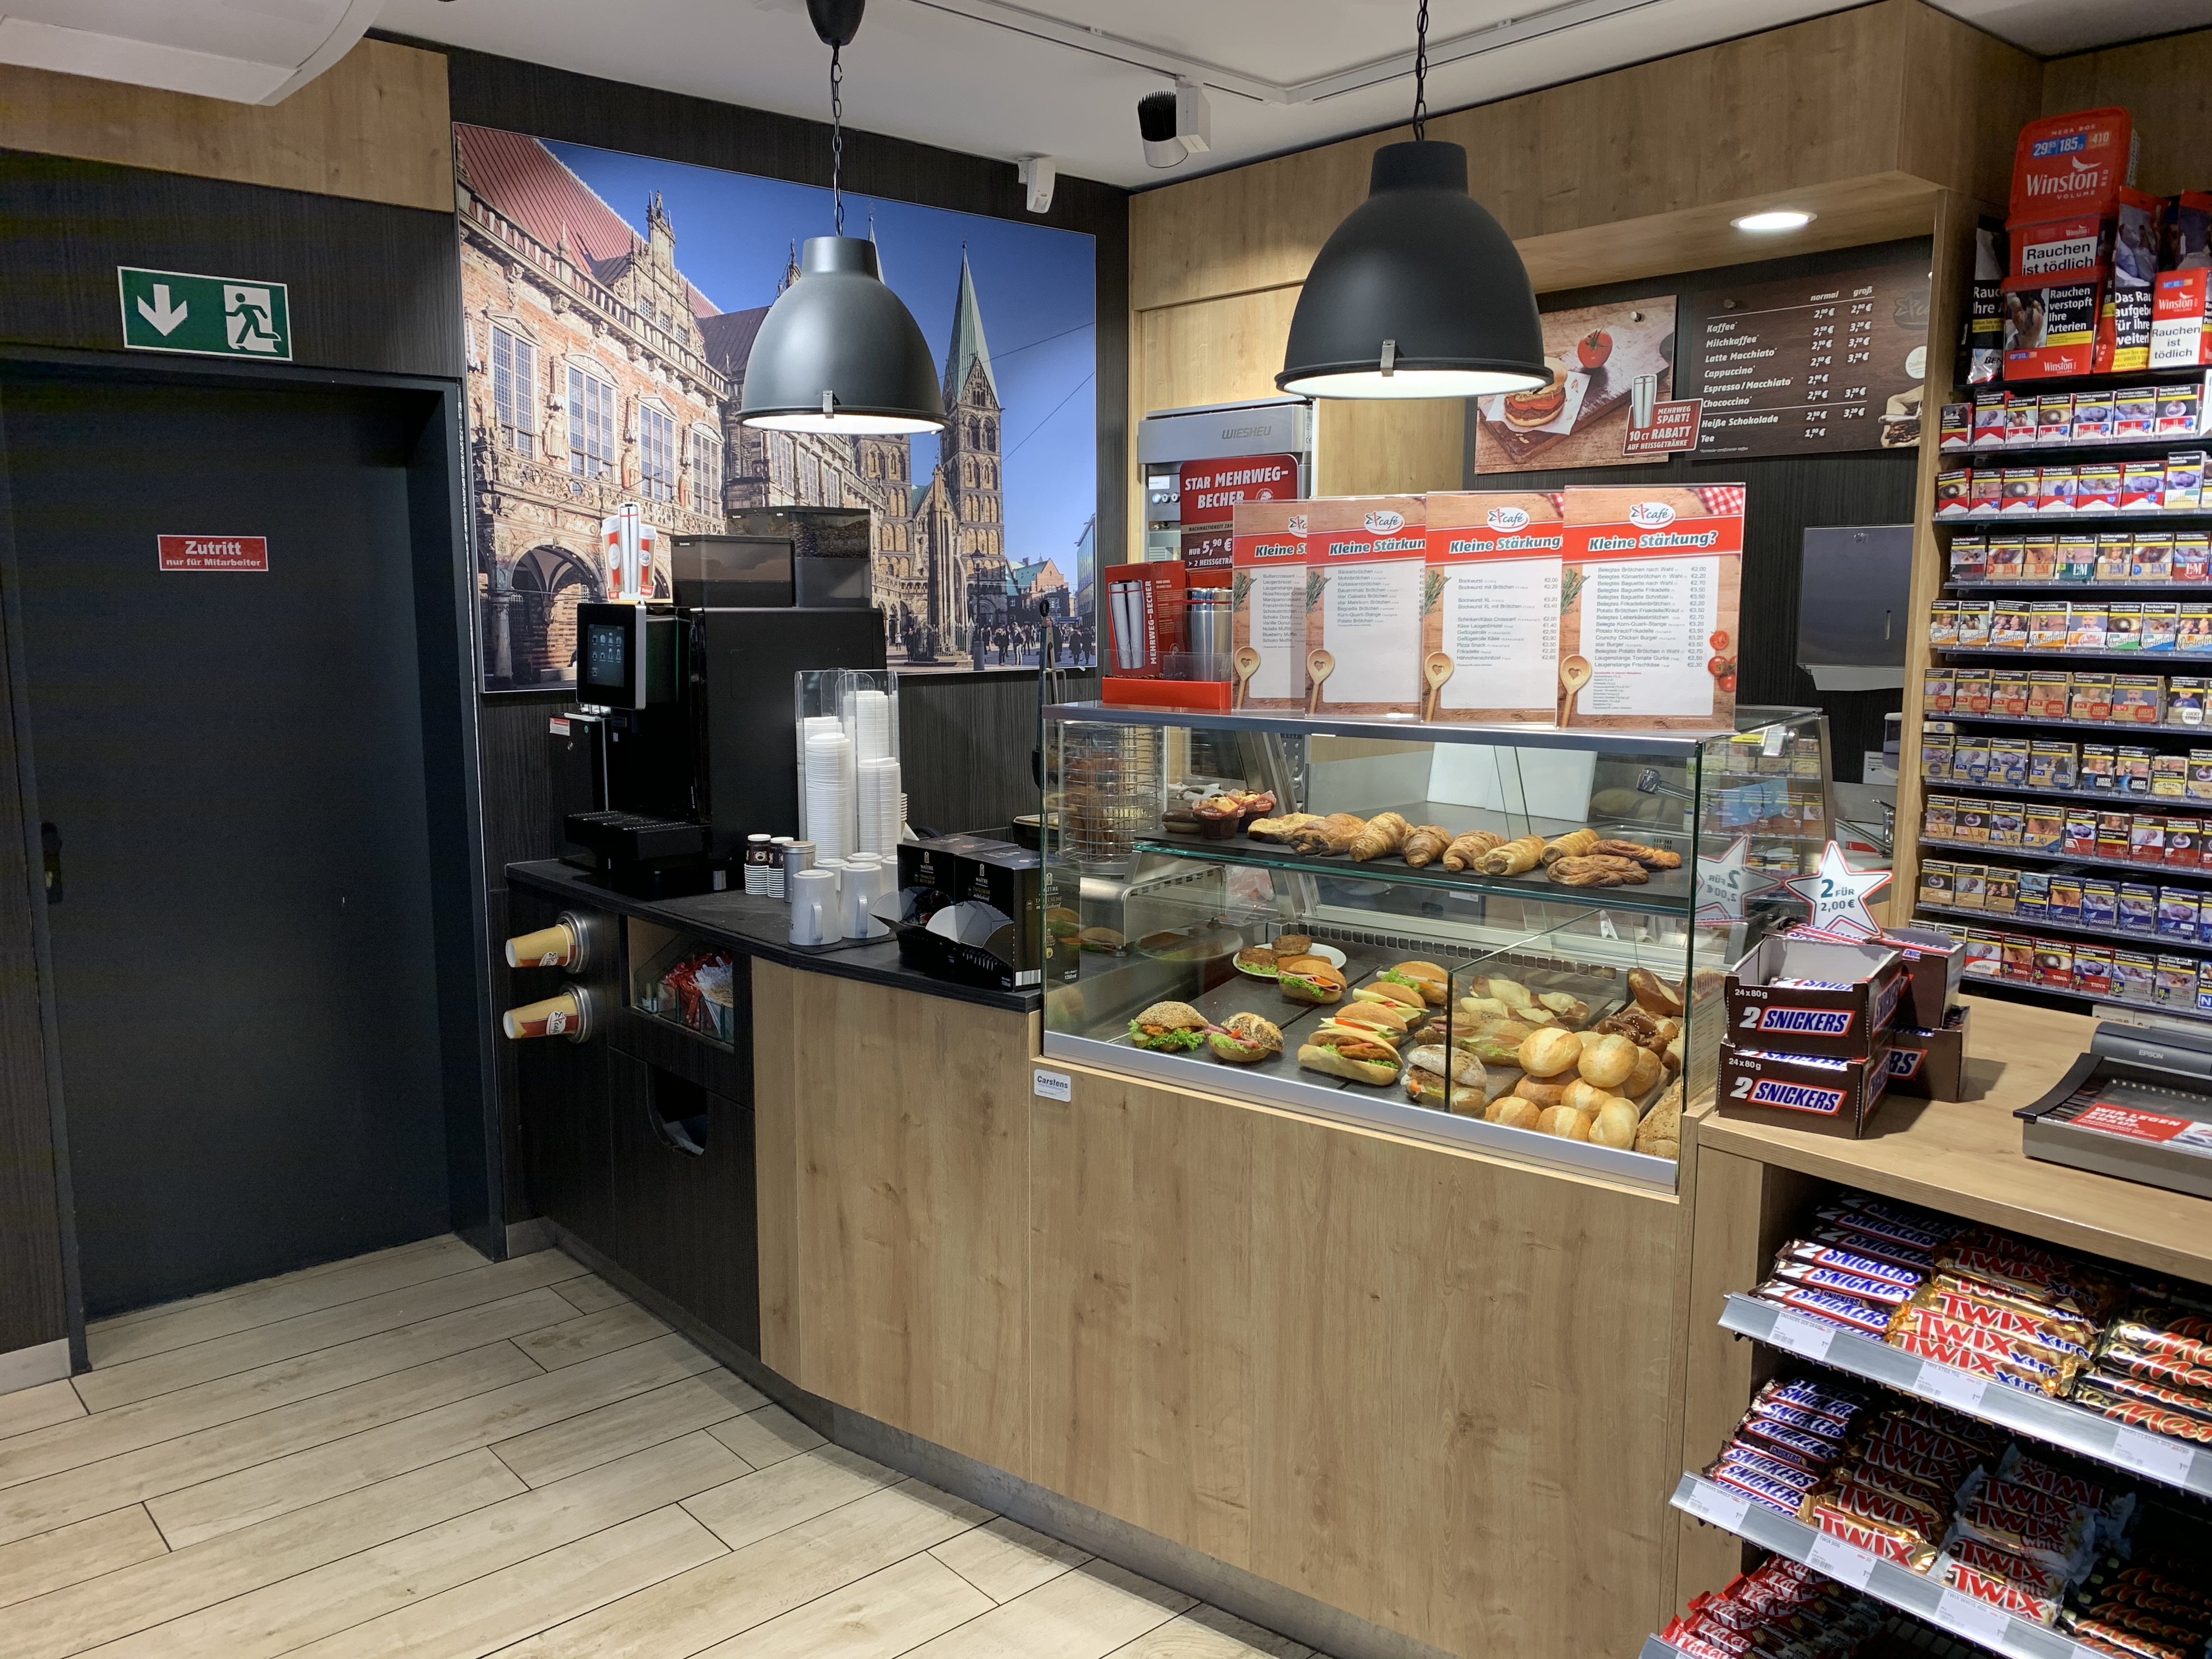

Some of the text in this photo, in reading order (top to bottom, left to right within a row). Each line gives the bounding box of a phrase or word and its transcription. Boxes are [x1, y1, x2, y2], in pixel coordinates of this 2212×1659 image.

[2092, 132, 2109, 144] 410
[2027, 171, 2098, 196] Winston
[2057, 190, 2095, 200] VOLUME
[2027, 243, 2090, 261] Rauchen
[2023, 256, 2094, 275] ist tödlich
[1810, 286, 1872, 302] normal groß
[2050, 287, 2090, 298] Rauchen
[2115, 292, 2134, 303] Das
[2049, 296, 2092, 311] verstopft
[2159, 298, 2193, 310] Winston
[2049, 312, 2067, 322] Ihre
[2048, 321, 2086, 334] Arterien
[2134, 319, 2149, 330] Ihre
[2152, 326, 2200, 337] Rauchen
[2168, 338, 2181, 347] ist
[1705, 354, 1728, 363] Latte
[2154, 348, 2192, 359] tödlich
[2044, 359, 2073, 372] Winston
[1658, 406, 1691, 414] MEHRWEG
[1657, 413, 1690, 424] SPART!
[1702, 419, 1726, 429] Heiße
[1729, 414, 1778, 427] Schokolade
[1222, 425, 1272, 440] WIESHEU
[1629, 431, 1640, 441] 10
[1651, 426, 1692, 439] RABATT
[1701, 435, 1714, 443] Tee
[1184, 466, 1289, 491] STAR MEHRWEG-
[1198, 490, 1244, 509] BECHER
[1451, 540, 1493, 553] Kleine
[1589, 531, 1718, 550] Kleine Stärkung?
[185, 540, 242, 555] Zutritt
[1255, 544, 1294, 557] Kleine
[1329, 544, 1370, 555] Kleine
[2073, 563, 2087, 575] L&M
[1145, 580, 1157, 664] MEHRWEG-BECHER
[2030, 632, 2064, 647] Chesterfield
[1820, 879, 1854, 898] 2 FÜR
[1735, 989, 1768, 999] 24x80g
[1739, 1007, 1851, 1033] 2 SNICKERS
[2138, 1049, 2164, 1059] EPSON
[1729, 1058, 1761, 1070] 24x80g
[1037, 1075, 1068, 1088] Carstens
[1730, 1077, 1842, 1112] 2 SNICKERS
[2090, 1111, 2138, 1123] EINEN
[2095, 1107, 2181, 1127] WIR LEGEN
[1822, 1249, 1921, 1285] SNICKERS
[1795, 1289, 1889, 1328] SNICKERS
[1771, 1446, 1801, 1463] SNICKERS
[1728, 1448, 1818, 1488] SNICKERS
[1723, 1465, 1804, 1507] SNICKERS
